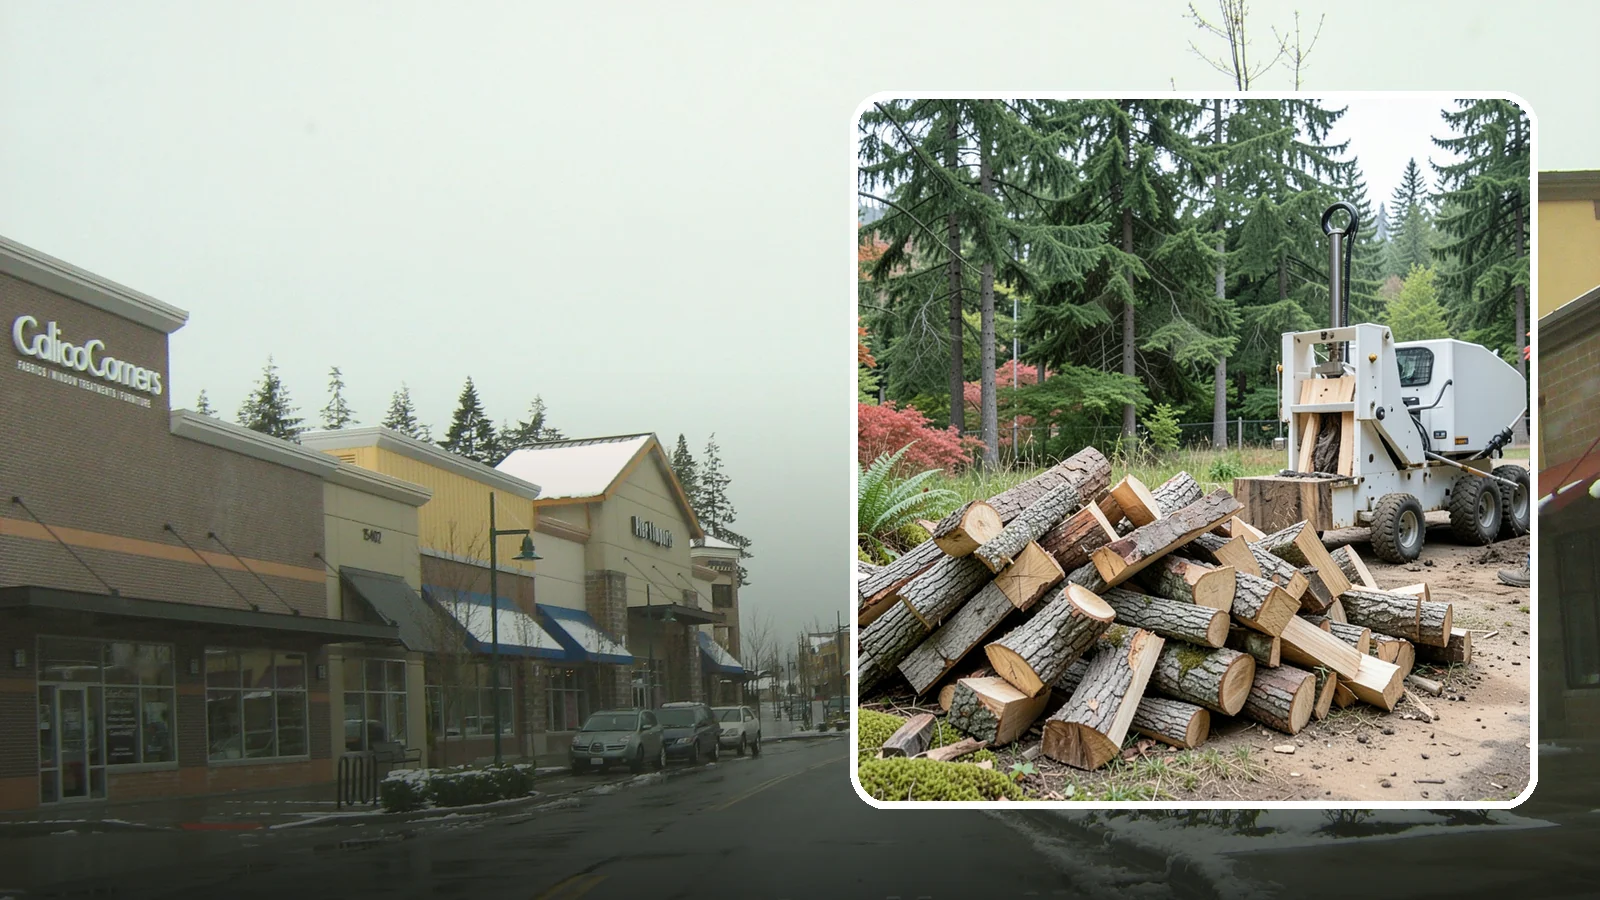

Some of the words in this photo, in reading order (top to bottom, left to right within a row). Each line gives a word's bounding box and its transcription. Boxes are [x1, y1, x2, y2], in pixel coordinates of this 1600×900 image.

[17, 360, 46, 377] FABRICS
[51, 370, 79, 387] WINDOW
[78, 378, 117, 398] TREATMENTS
[120, 391, 152, 409] FURNITURE
